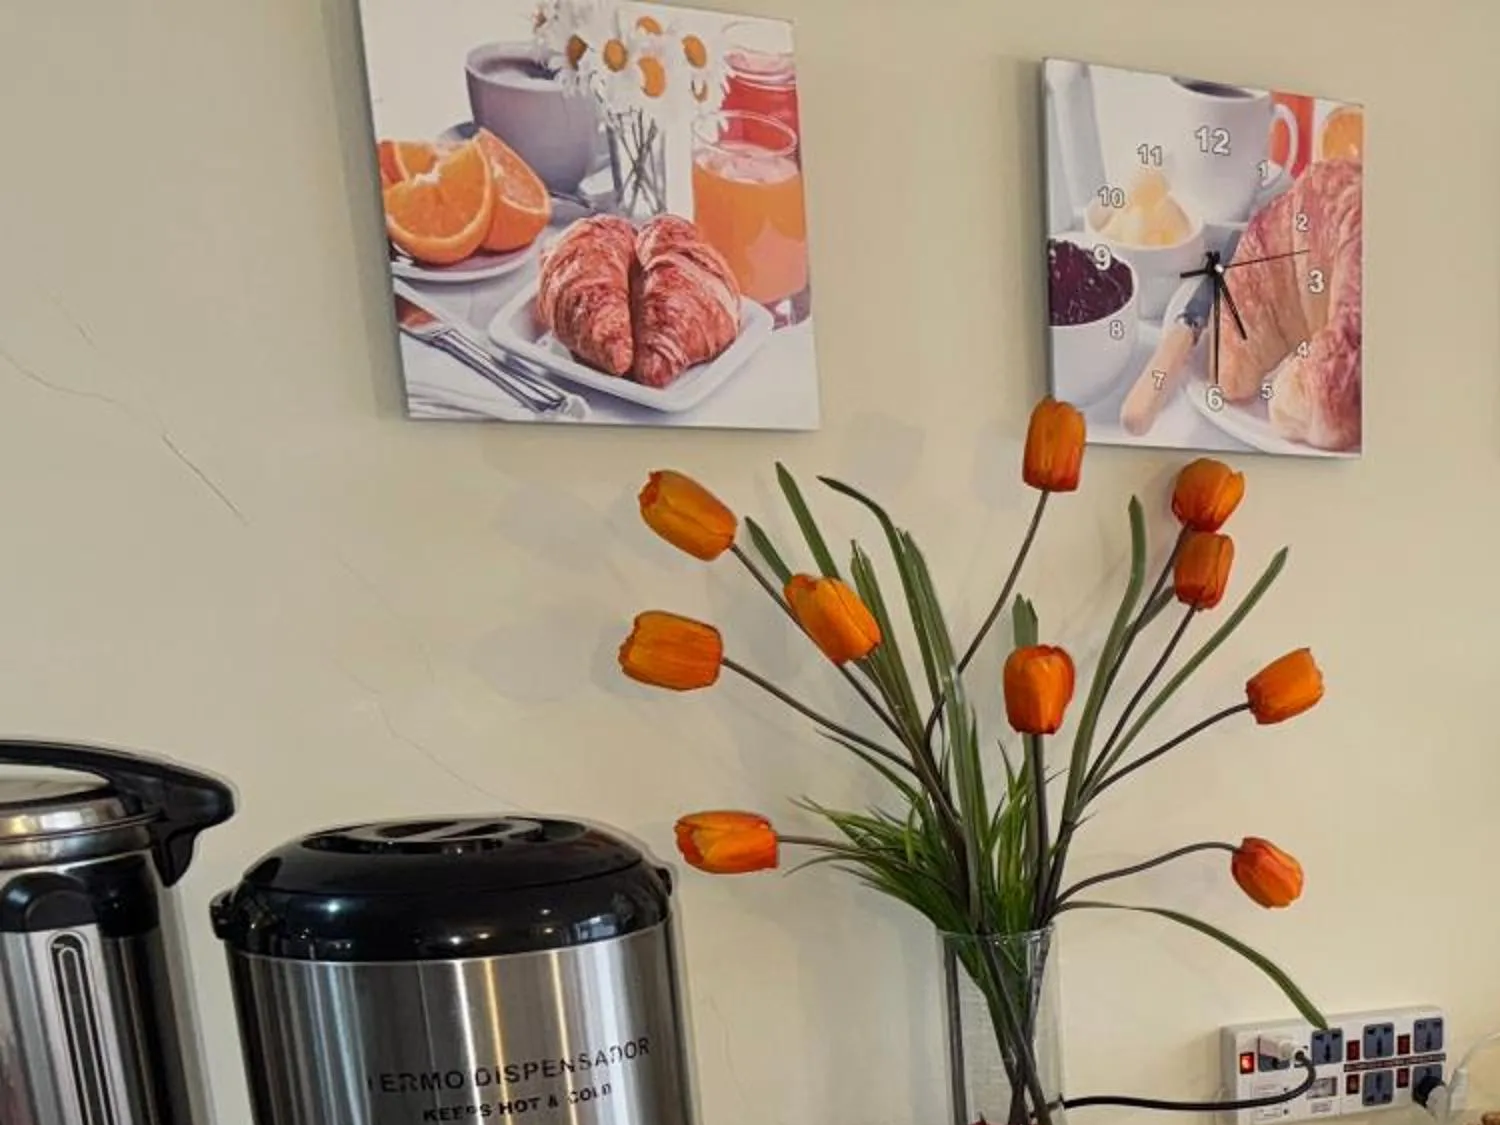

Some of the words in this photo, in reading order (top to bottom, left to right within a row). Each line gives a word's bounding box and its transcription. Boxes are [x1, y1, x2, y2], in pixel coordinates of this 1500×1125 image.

[1195, 126, 1231, 156] 12
[1136, 143, 1163, 166] 11
[1098, 185, 1126, 208] 10
[1295, 213, 1309, 232] 2
[1094, 244, 1112, 271] 9
[1308, 269, 1325, 294] 3
[1109, 321, 1125, 340] 8
[1296, 341, 1311, 359] 4
[1151, 370, 1167, 389] 7
[1205, 384, 1225, 411] 6
[1260, 384, 1274, 400] 5
[475, 1037, 650, 1088] DISPENSADOR
[499, 1097, 541, 1116] HOT
